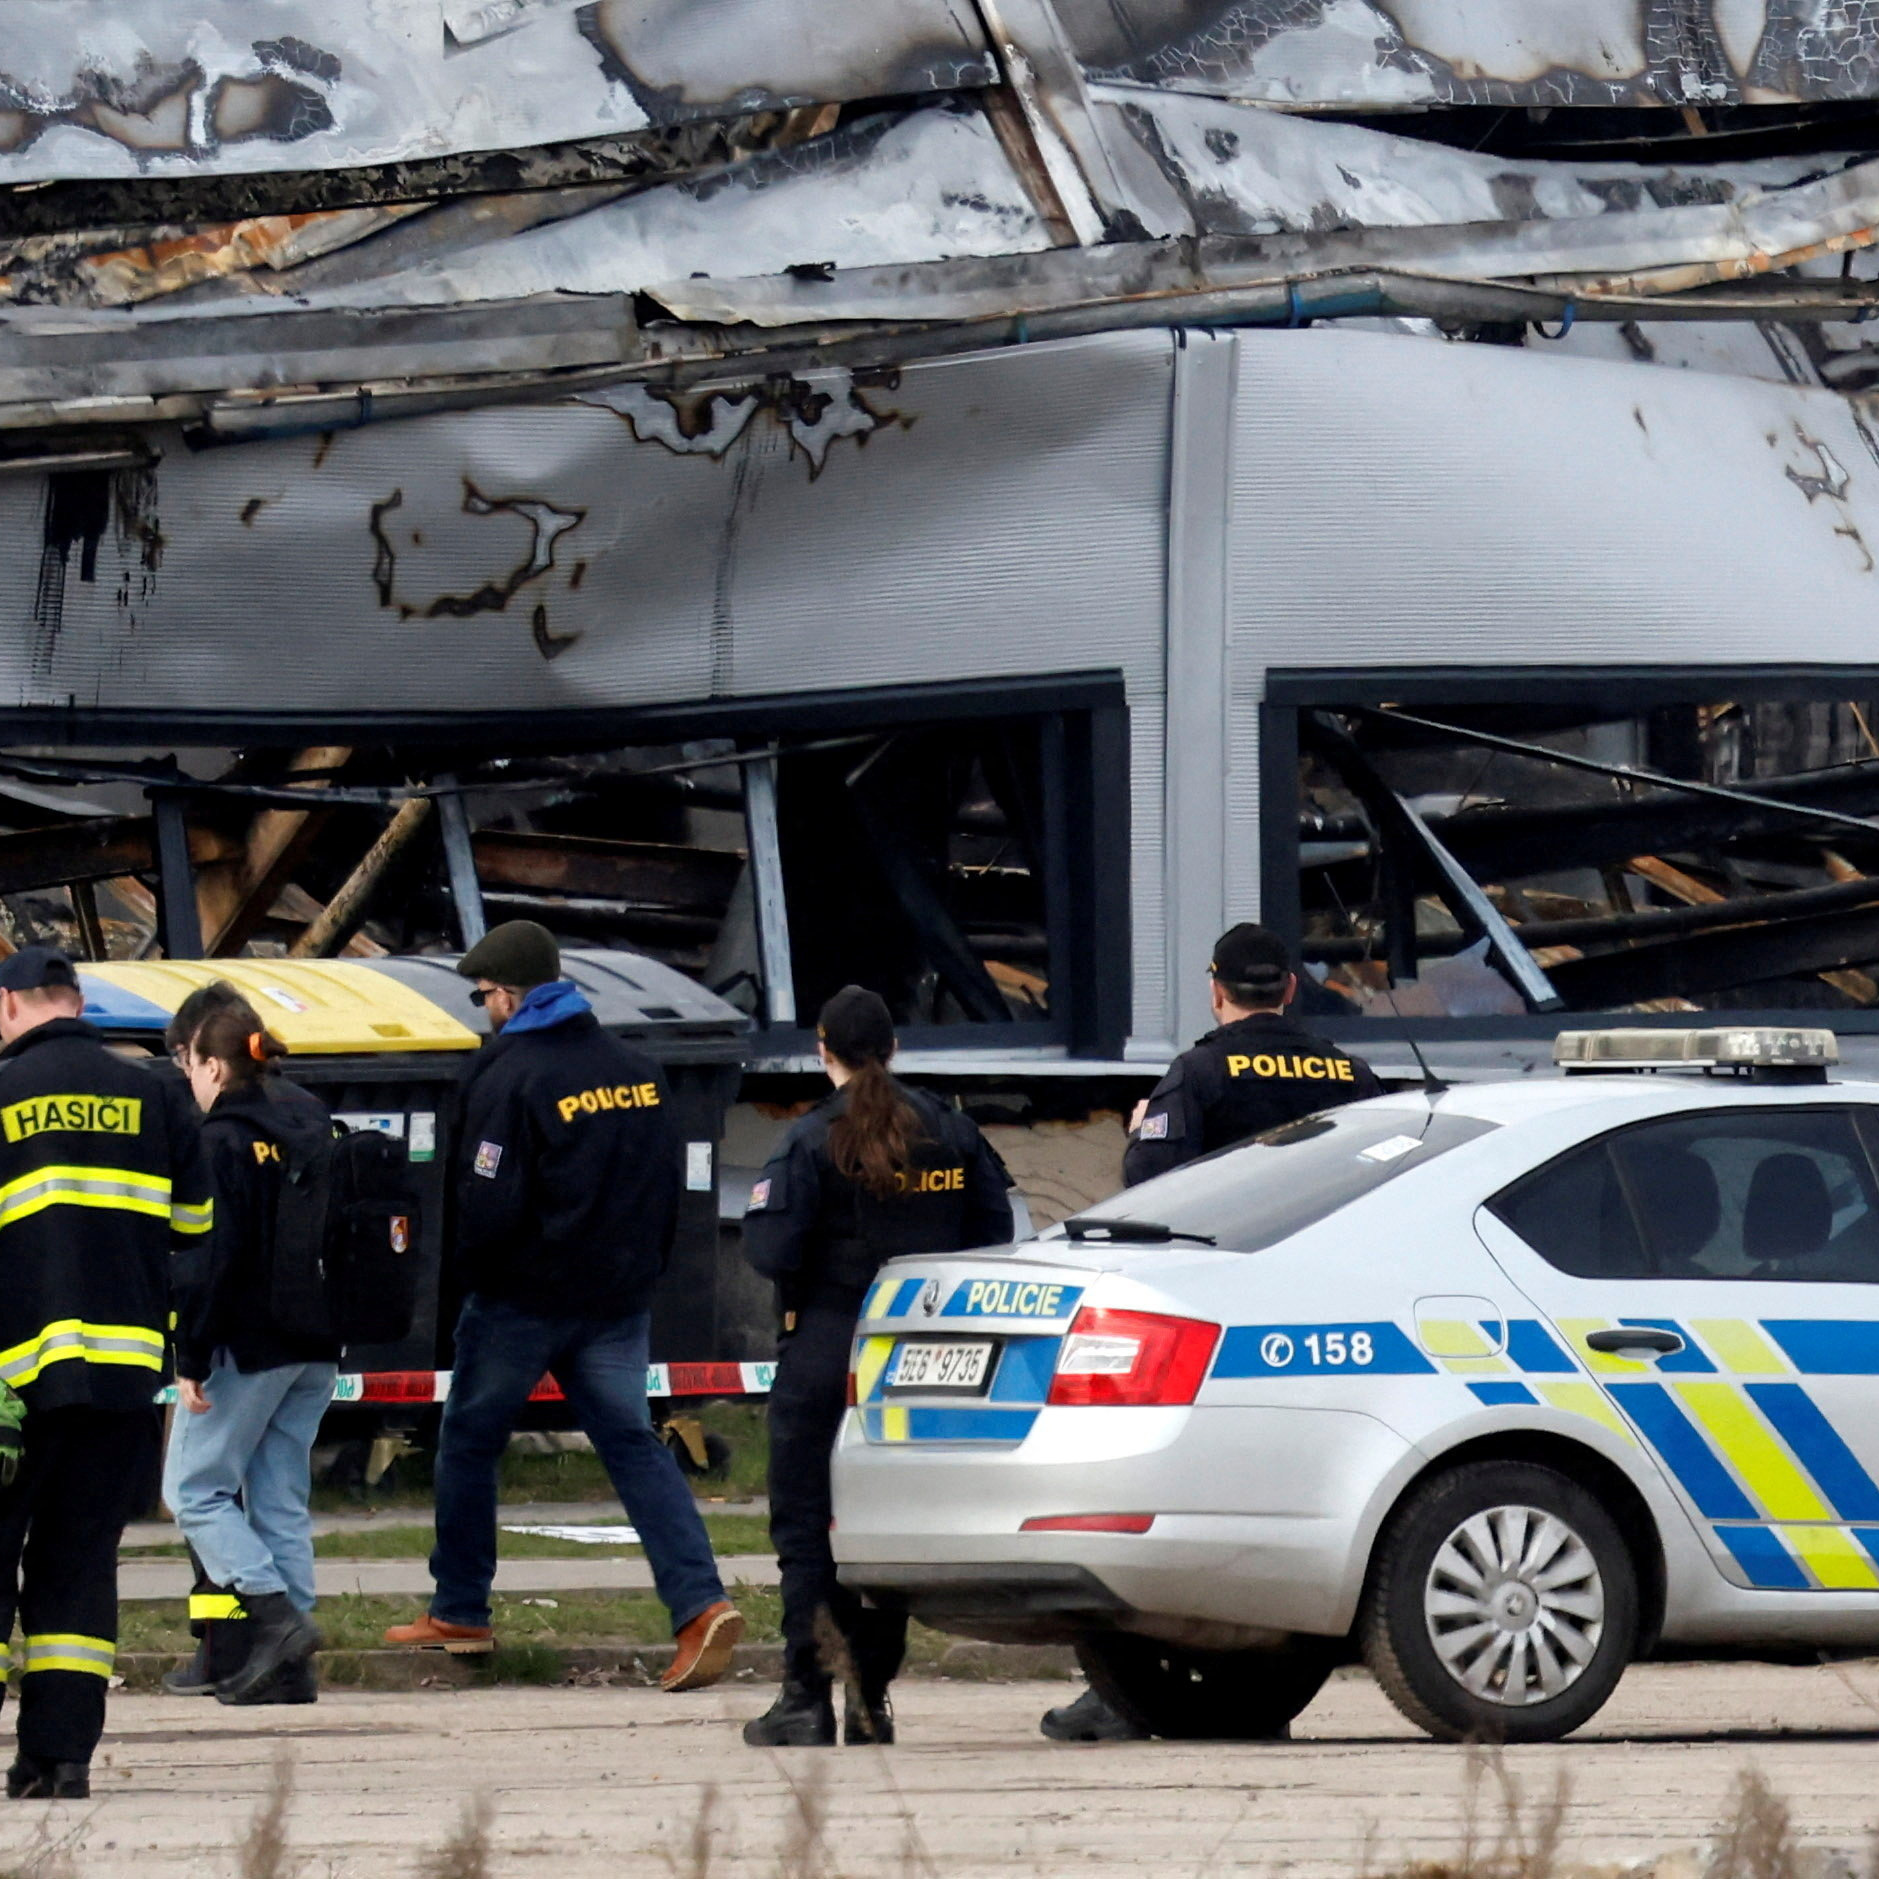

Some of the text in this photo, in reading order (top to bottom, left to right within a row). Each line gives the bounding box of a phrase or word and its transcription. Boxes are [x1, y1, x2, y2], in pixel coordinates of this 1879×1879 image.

[1226, 1054, 1354, 1082] POLICIE
[16, 1096, 130, 1136] HASIČI
[557, 1083, 660, 1123] POLICIE
[966, 1282, 1065, 1316] POLICIE
[938, 1348, 984, 1382] 9735
[1304, 1331, 1373, 1366] 158
